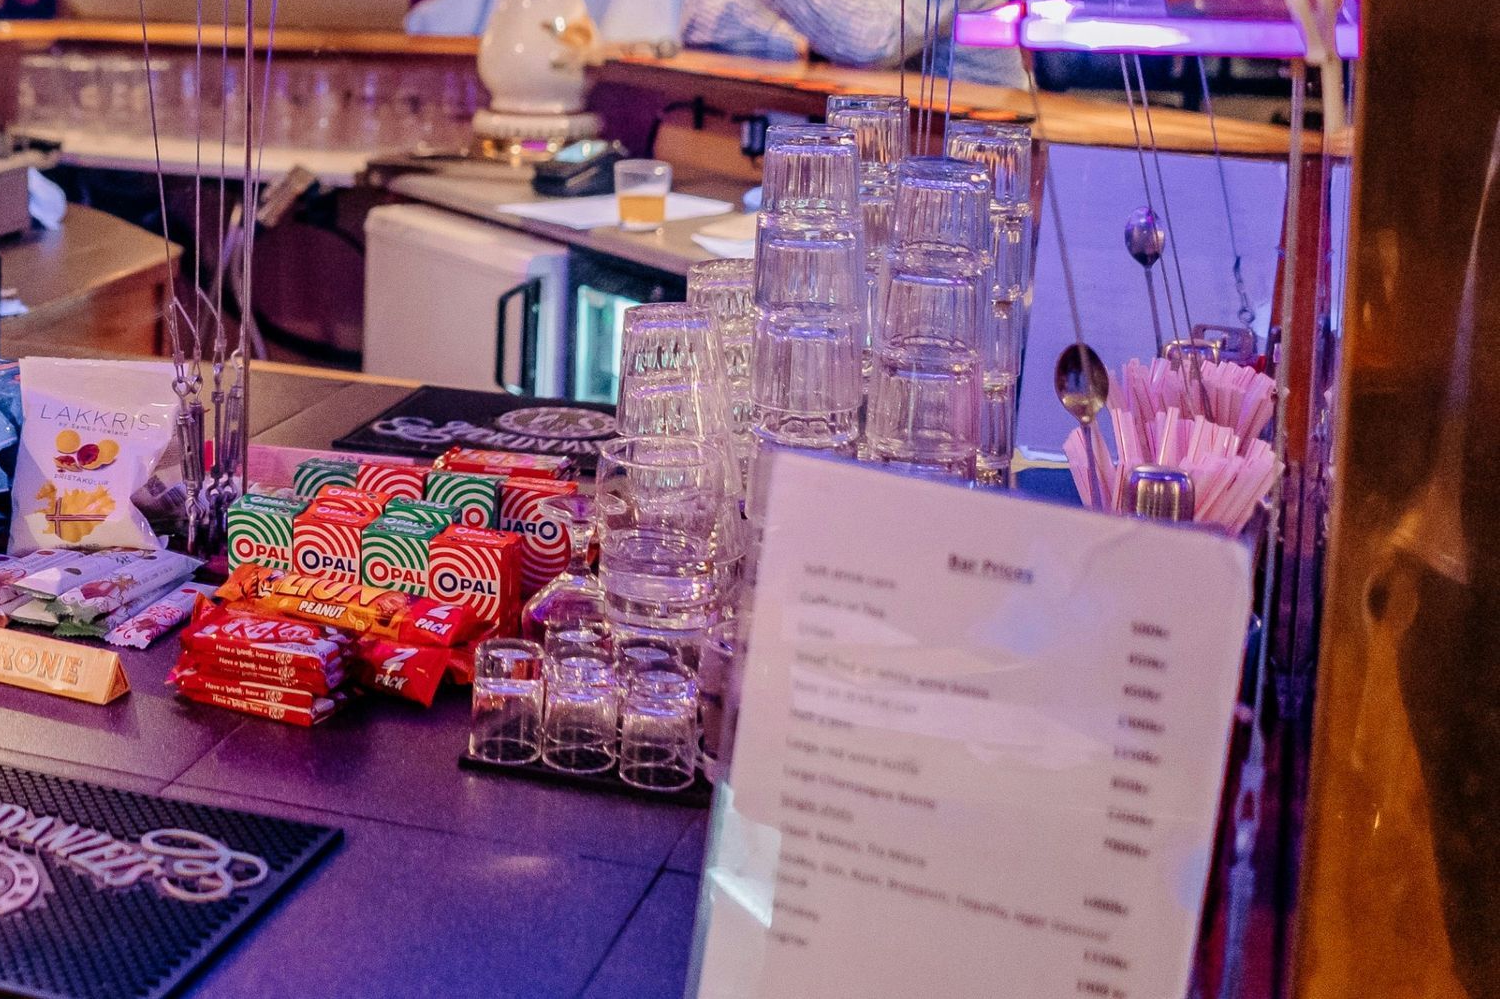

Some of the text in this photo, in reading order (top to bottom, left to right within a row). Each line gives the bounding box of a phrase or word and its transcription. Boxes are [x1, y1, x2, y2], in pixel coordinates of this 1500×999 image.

[40, 404, 150, 432] LAKKRIS
[235, 539, 289, 562] OPAL
[302, 549, 357, 573] OPAL
[369, 561, 426, 586] OPAL
[438, 572, 497, 596] OPAL
[276, 576, 387, 605] LION
[300, 600, 346, 618] PEANUT
[425, 605, 453, 617] 2
[415, 618, 451, 635] PACK
[216, 644, 230, 653] Have
[256, 651, 269, 659] have
[380, 648, 417, 670] 2
[374, 674, 409, 690] PACK
